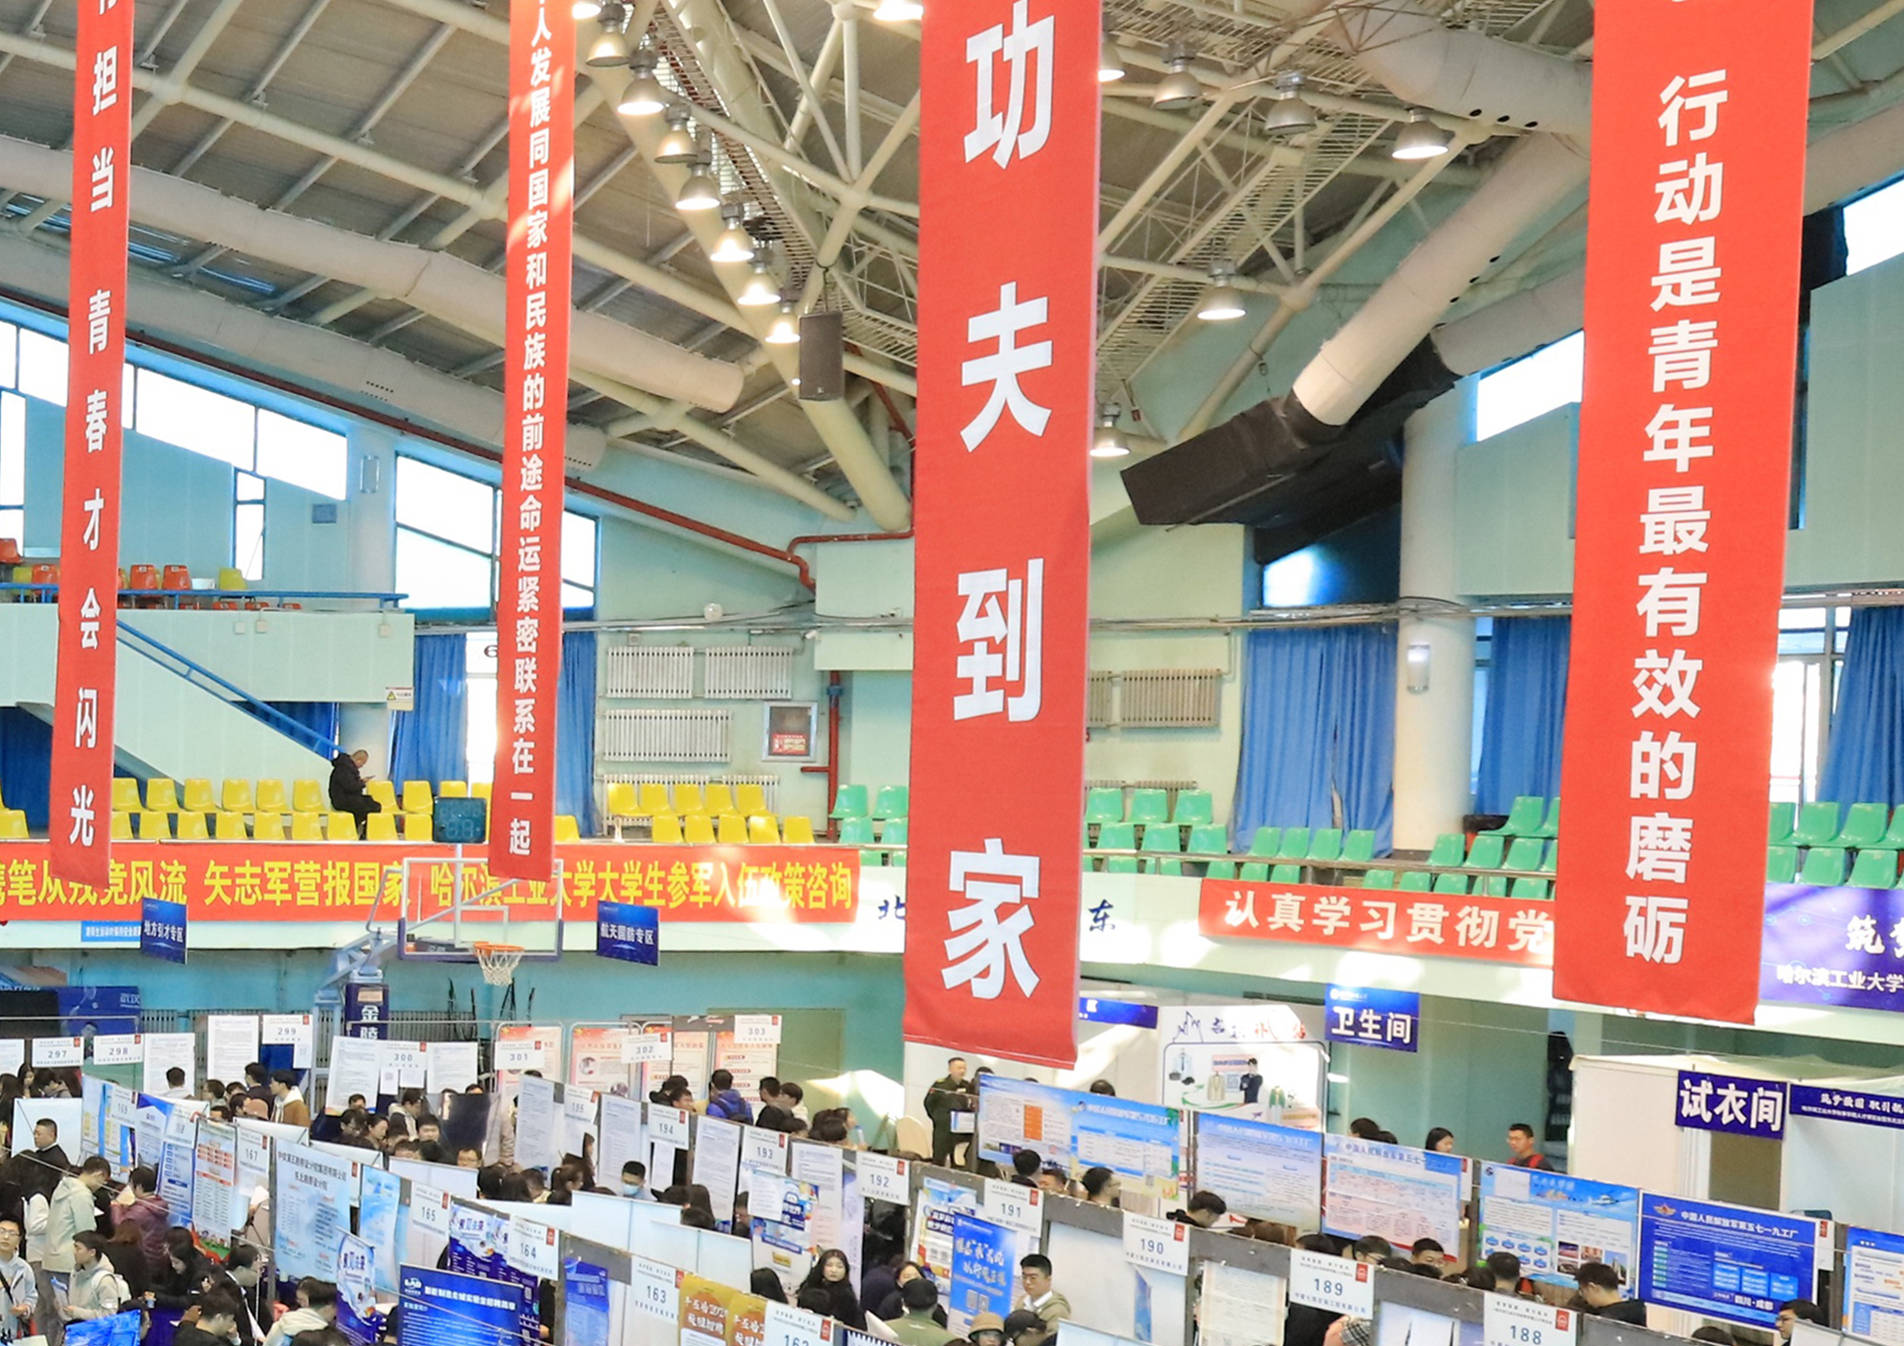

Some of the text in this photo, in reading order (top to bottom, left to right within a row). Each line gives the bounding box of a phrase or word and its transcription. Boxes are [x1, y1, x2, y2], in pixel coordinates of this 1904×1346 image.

[90, 0, 118, 211] 担当
[508, 0, 554, 858] 人发展同国家和民族的前途命运紧密联系在一起
[940, 9, 1054, 1001] 功夫到家
[1624, 68, 1730, 965] 行动是青年最有效的磨砺
[69, 288, 111, 847] 青春才会闪光
[204, 859, 411, 909] 矢志军营报国家
[143, 922, 184, 945] 地方引才专区
[1091, 897, 1117, 936] 东
[1224, 890, 1555, 955] 认真学习贯彻党
[1331, 1004, 1412, 1045] 卫生间
[47, 1049, 67, 1059] 297
[1680, 1079, 1785, 1133] 试衣间
[869, 1173, 890, 1188] 192
[1001, 1202, 1021, 1218] 191
[1140, 1238, 1164, 1255] 190
[646, 1285, 667, 1304] 163
[1314, 1278, 1343, 1297] 189
[1510, 1325, 1542, 1346] 188
